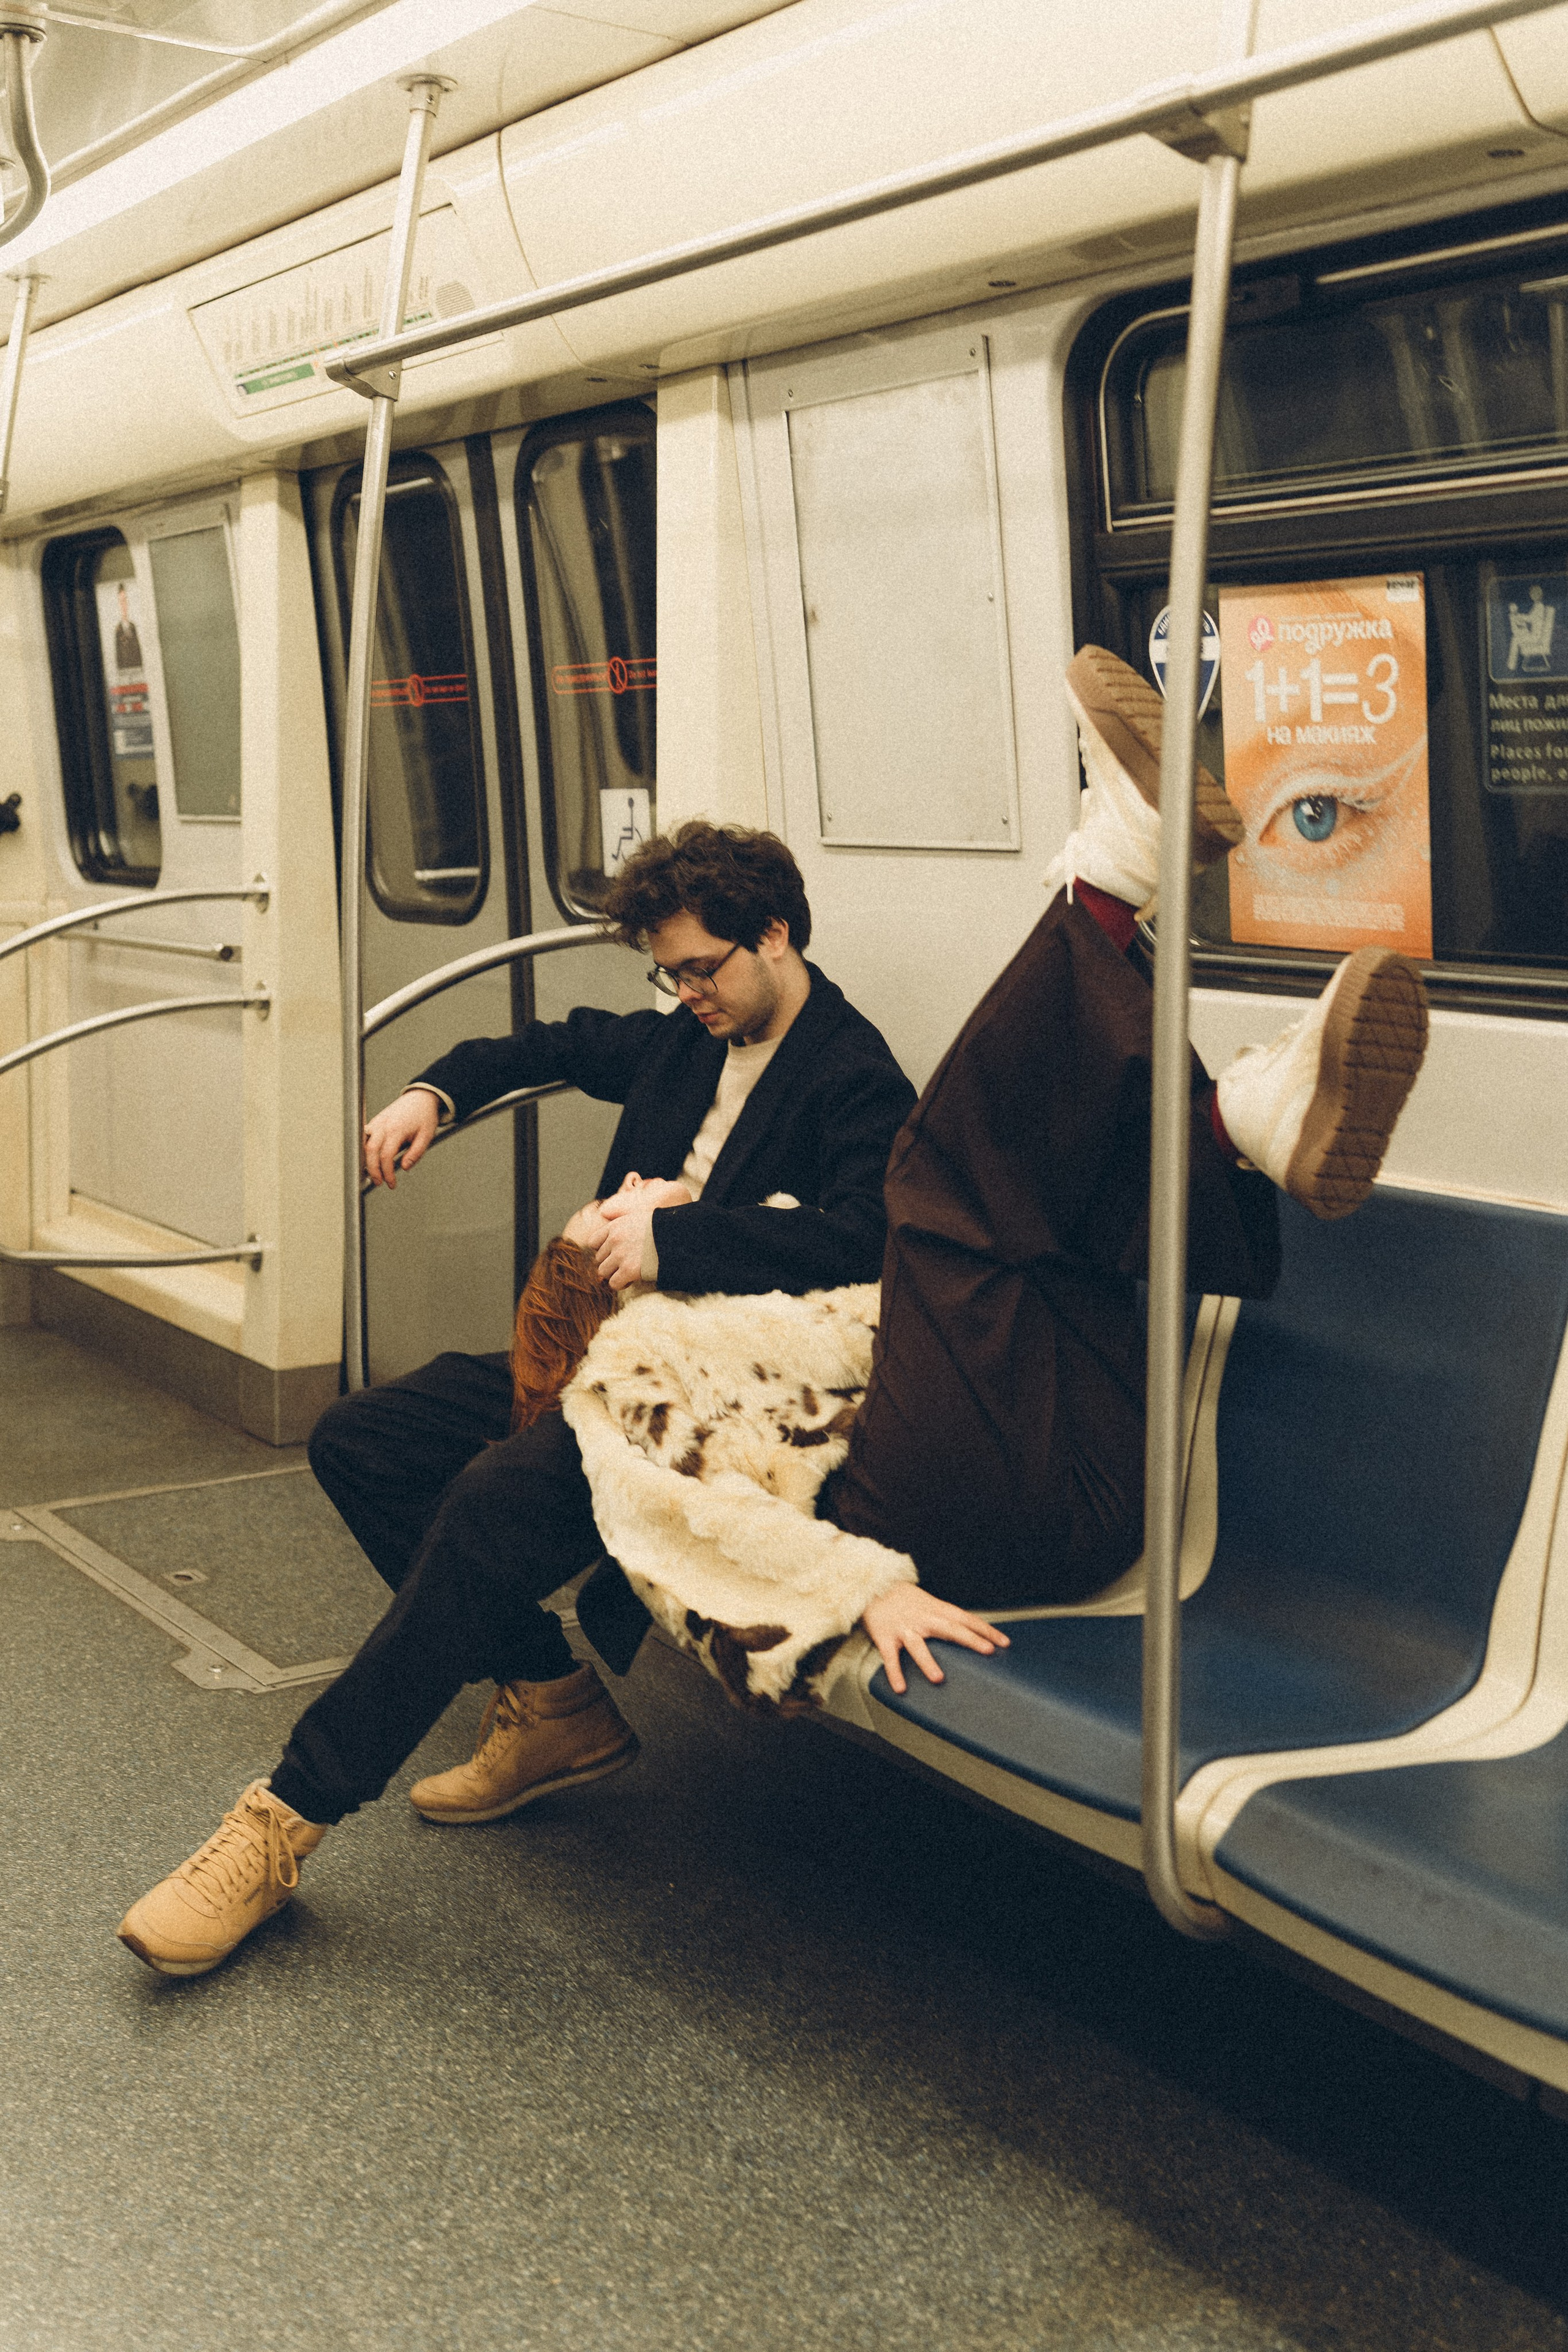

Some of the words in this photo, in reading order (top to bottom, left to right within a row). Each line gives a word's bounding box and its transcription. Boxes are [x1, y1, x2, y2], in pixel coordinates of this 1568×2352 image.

[1278, 618, 1393, 655] подружка
[1244, 652, 1399, 724] 1+1=3
[1489, 693, 1539, 709] Места
[1523, 718, 1568, 732] пожи
[1267, 725, 1292, 745] на
[1295, 725, 1377, 745] макияж
[1490, 744, 1542, 760] Places
[1491, 764, 1553, 783] people,
